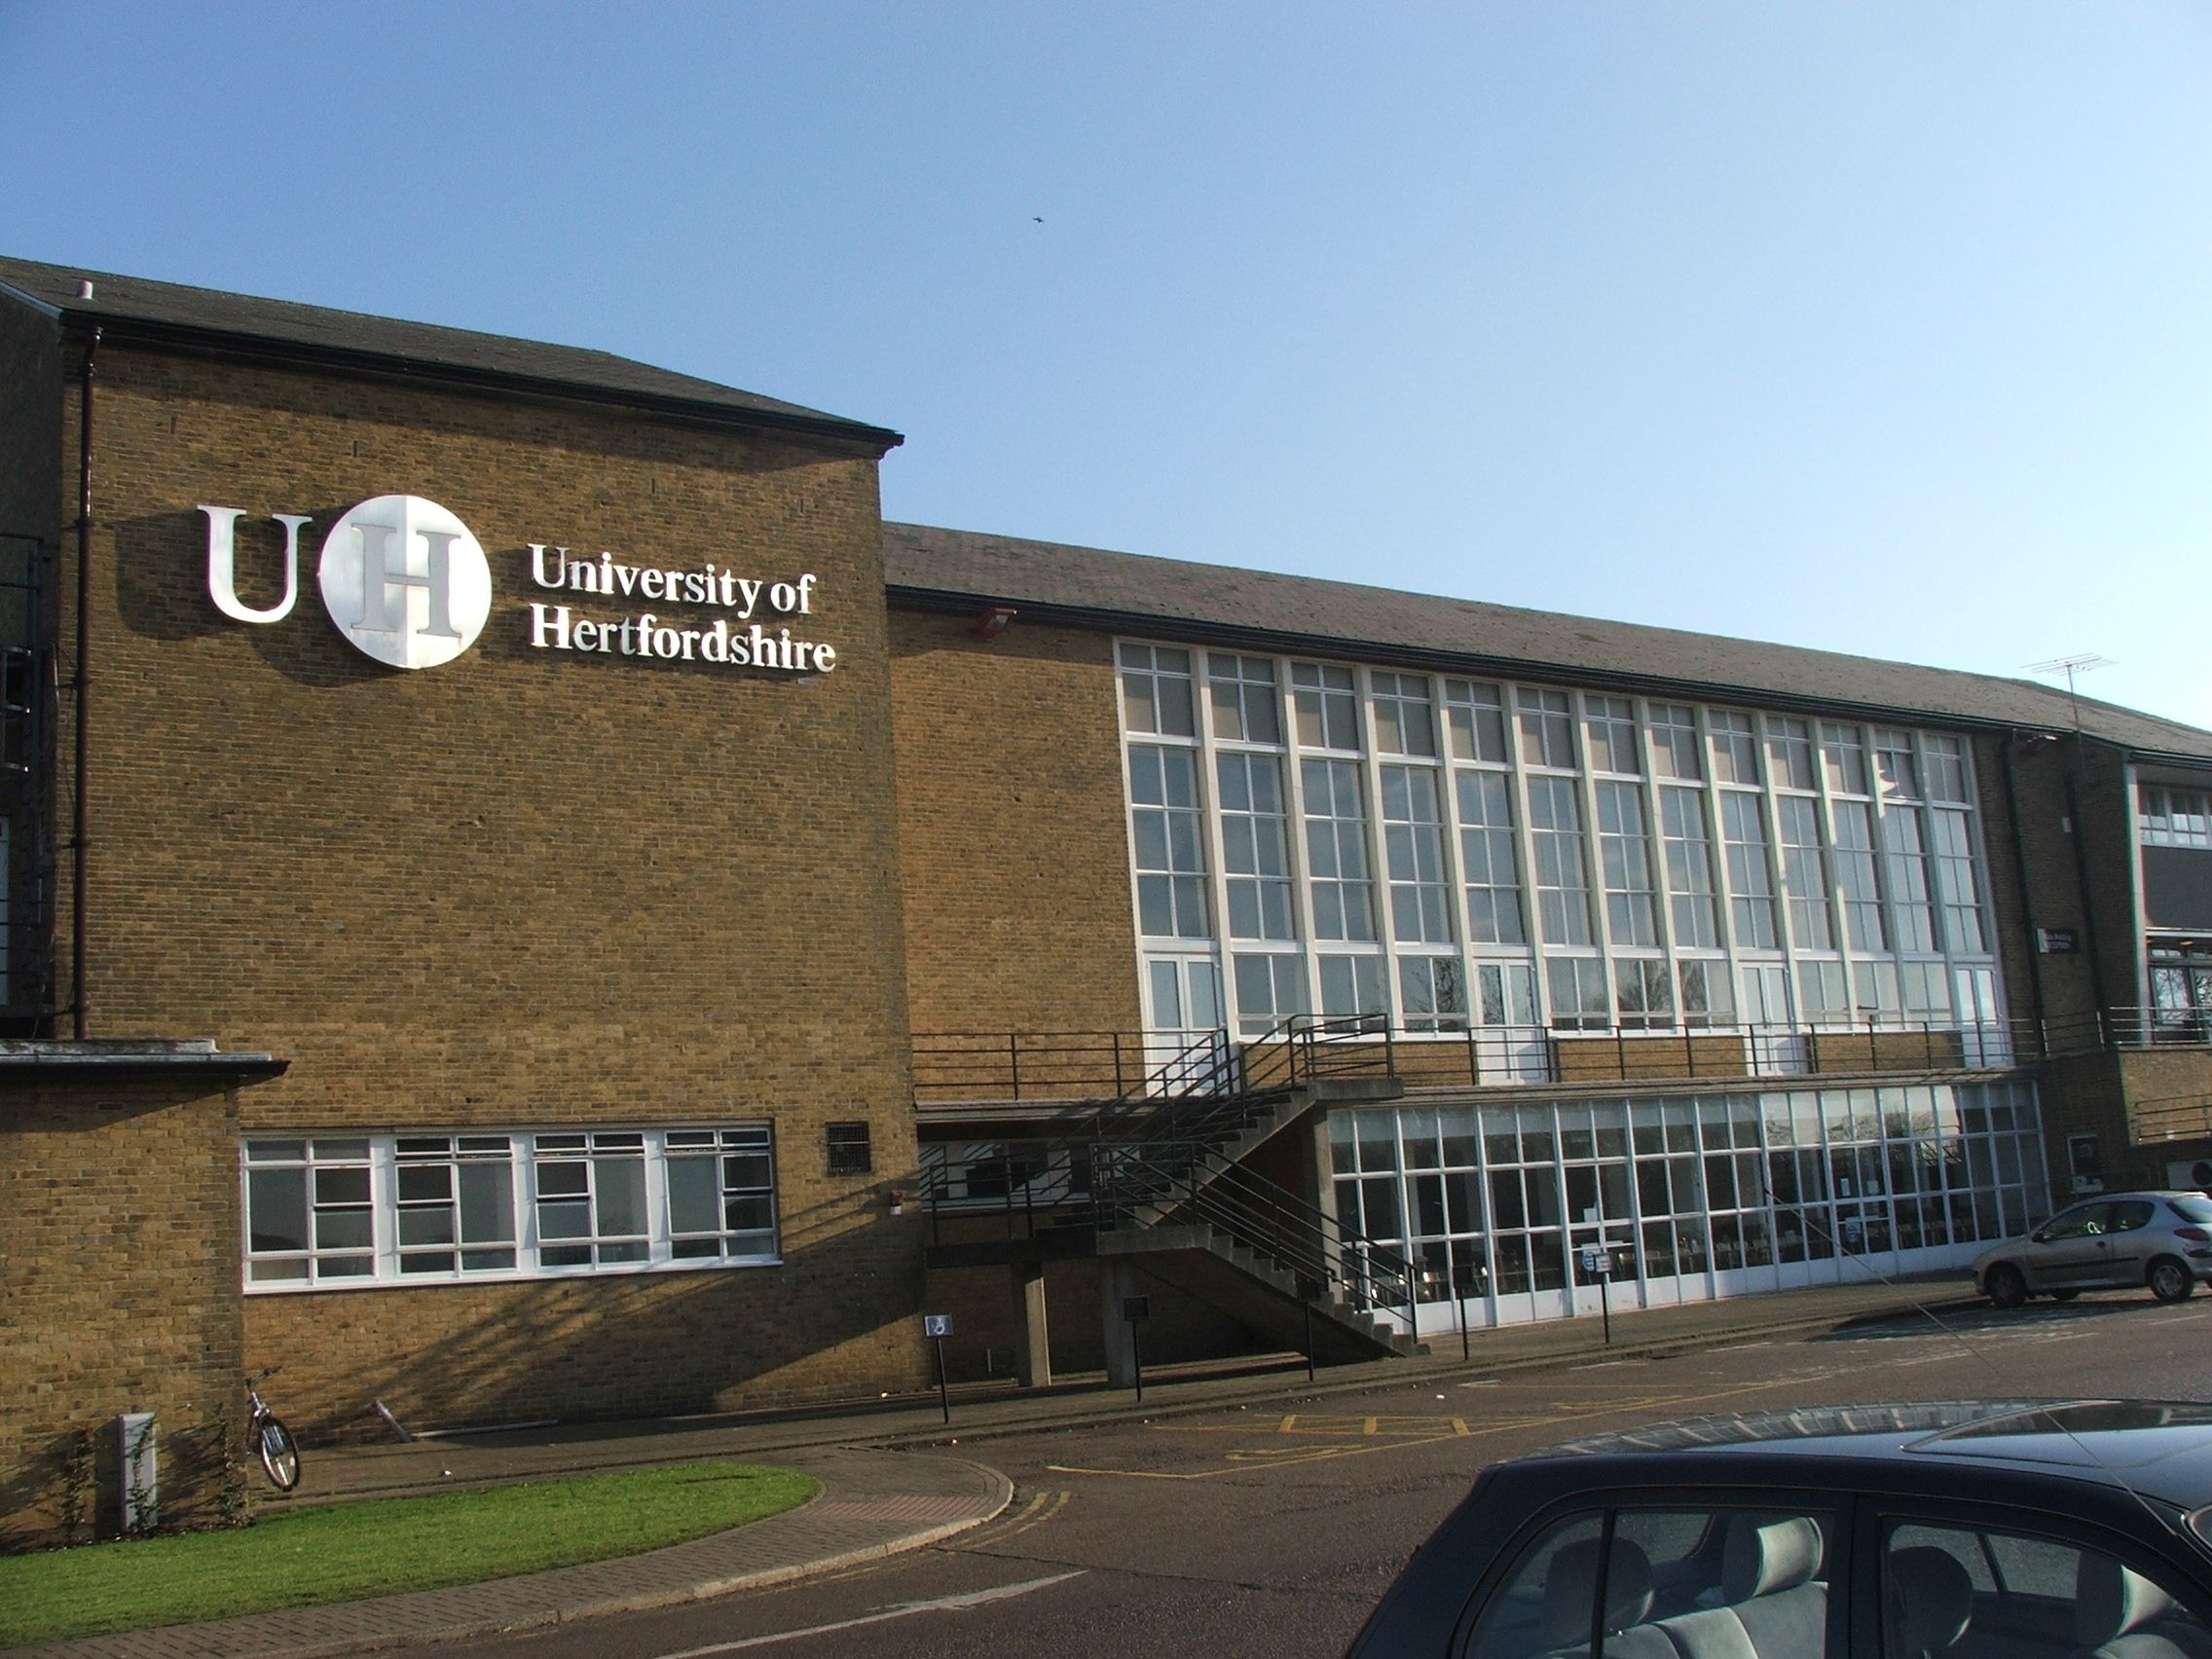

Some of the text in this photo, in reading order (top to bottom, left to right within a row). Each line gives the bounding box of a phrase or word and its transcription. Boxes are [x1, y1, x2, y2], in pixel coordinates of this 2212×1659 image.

[528, 543, 817, 619] University of
[530, 603, 836, 673] Hertfordshire
